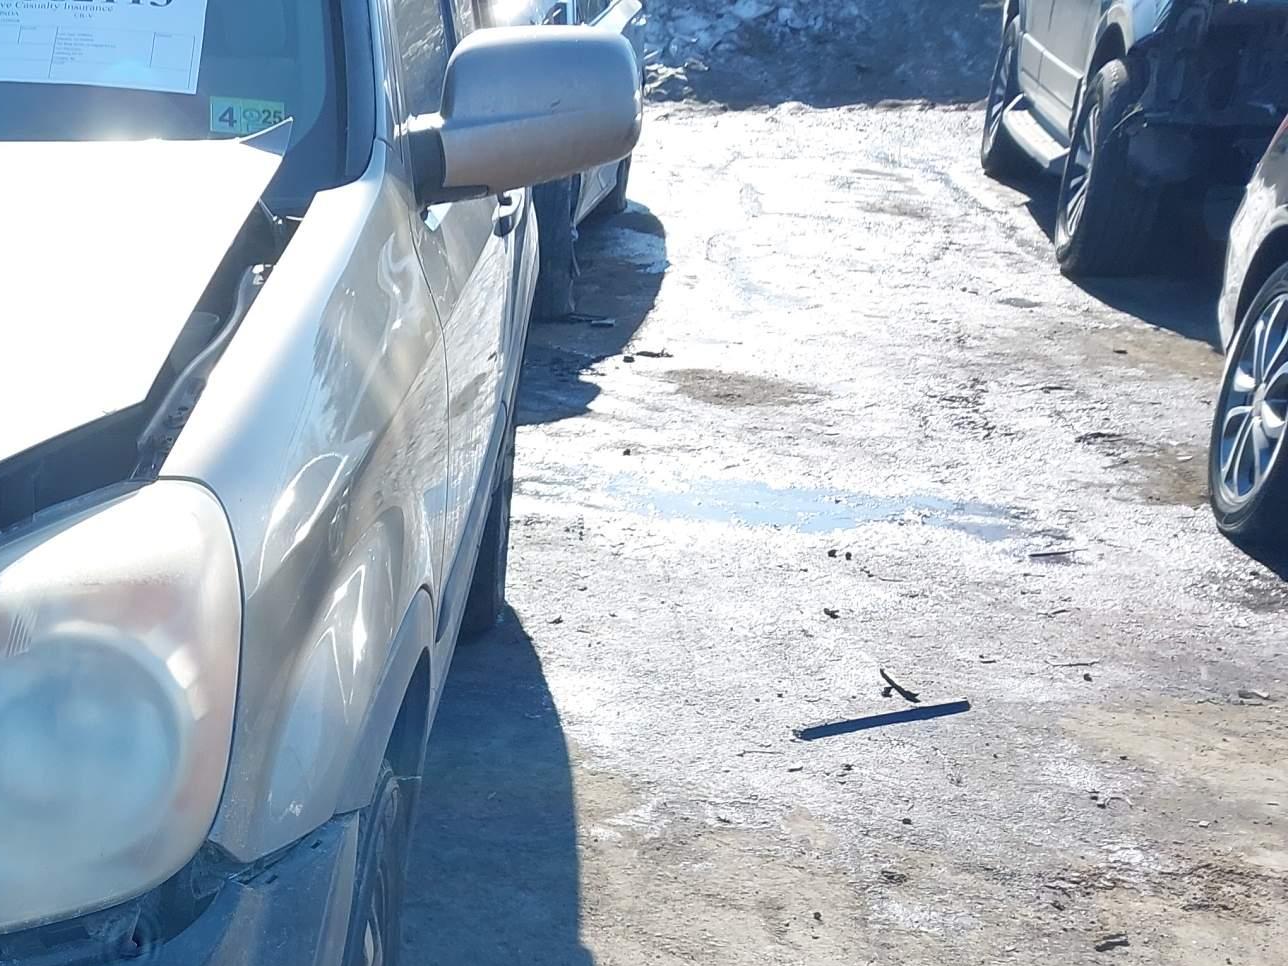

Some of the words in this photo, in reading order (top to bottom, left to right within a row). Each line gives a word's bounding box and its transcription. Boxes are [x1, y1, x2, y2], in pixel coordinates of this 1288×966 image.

[15, 0, 60, 11] Casualty
[63, 2, 114, 13] Insurance
[218, 105, 238, 128] 4
[262, 109, 282, 125] 25
